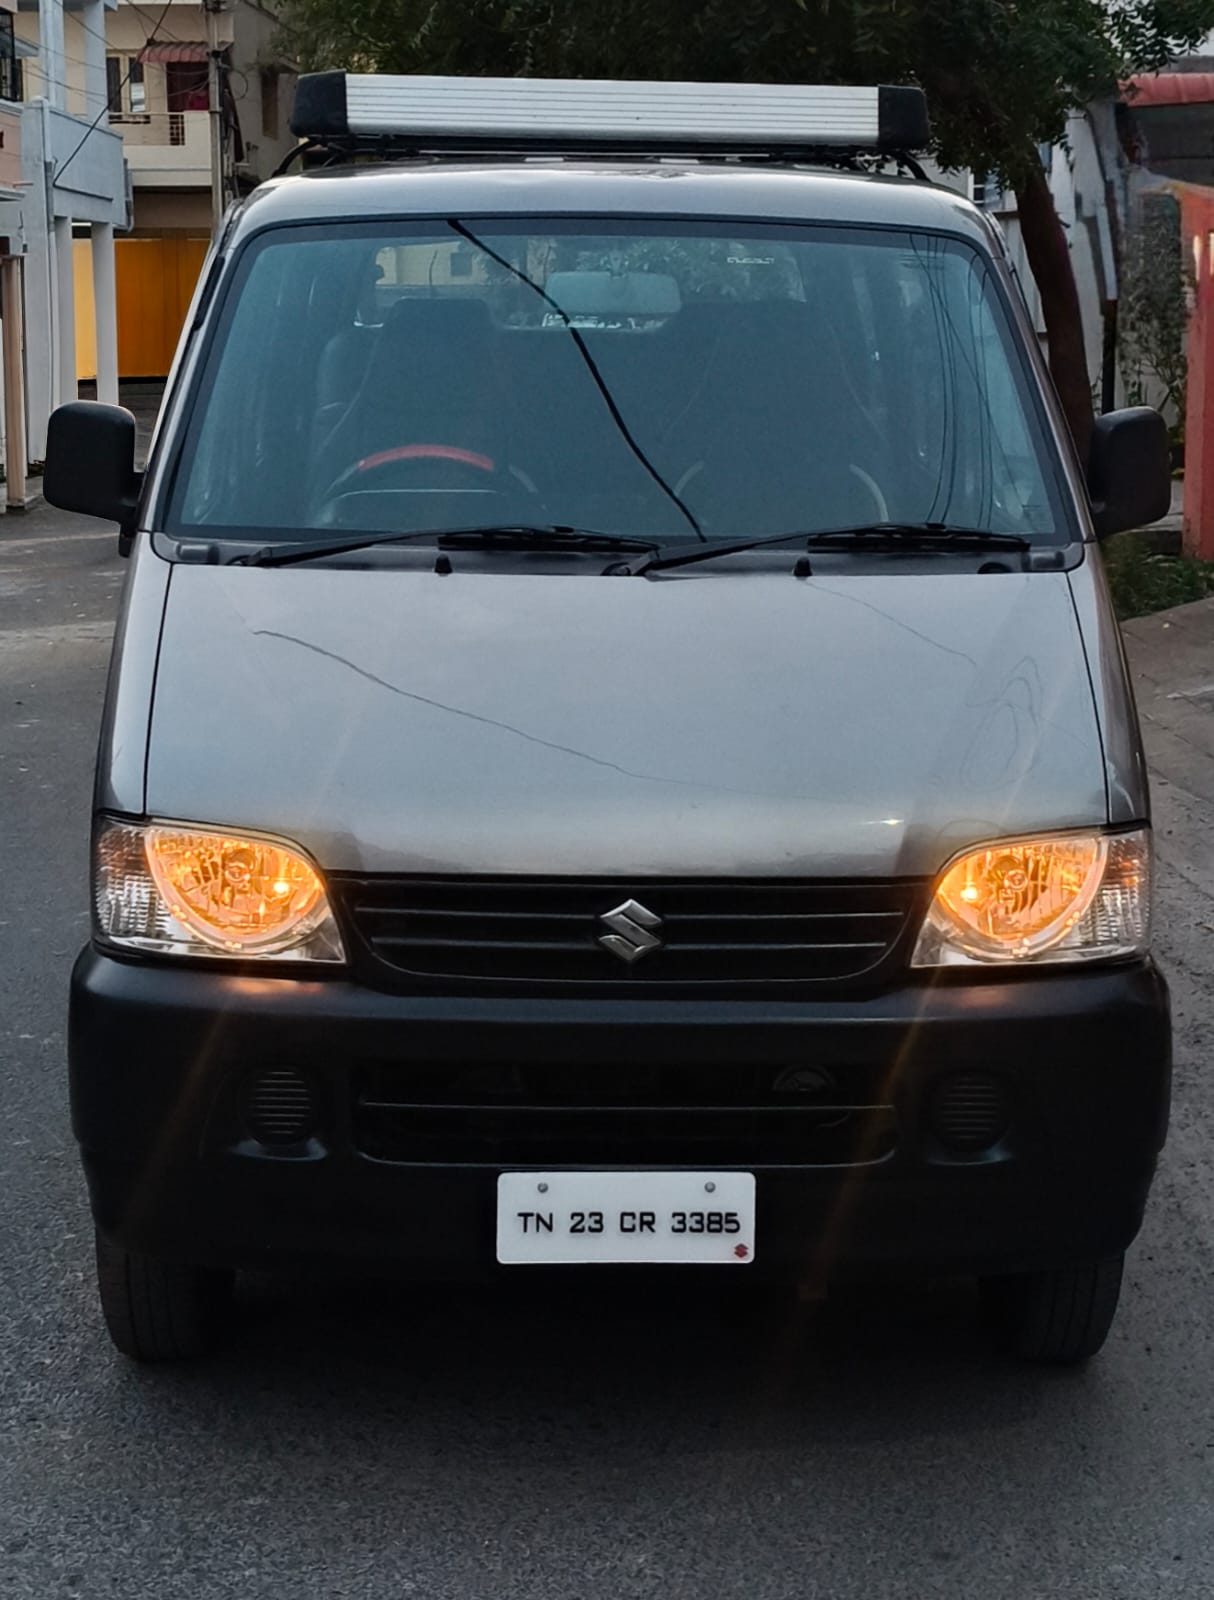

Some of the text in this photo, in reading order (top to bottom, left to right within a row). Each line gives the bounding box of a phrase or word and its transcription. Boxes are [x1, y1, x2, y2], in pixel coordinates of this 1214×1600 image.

[517, 1211, 740, 1234] TN 23 CR 3385
